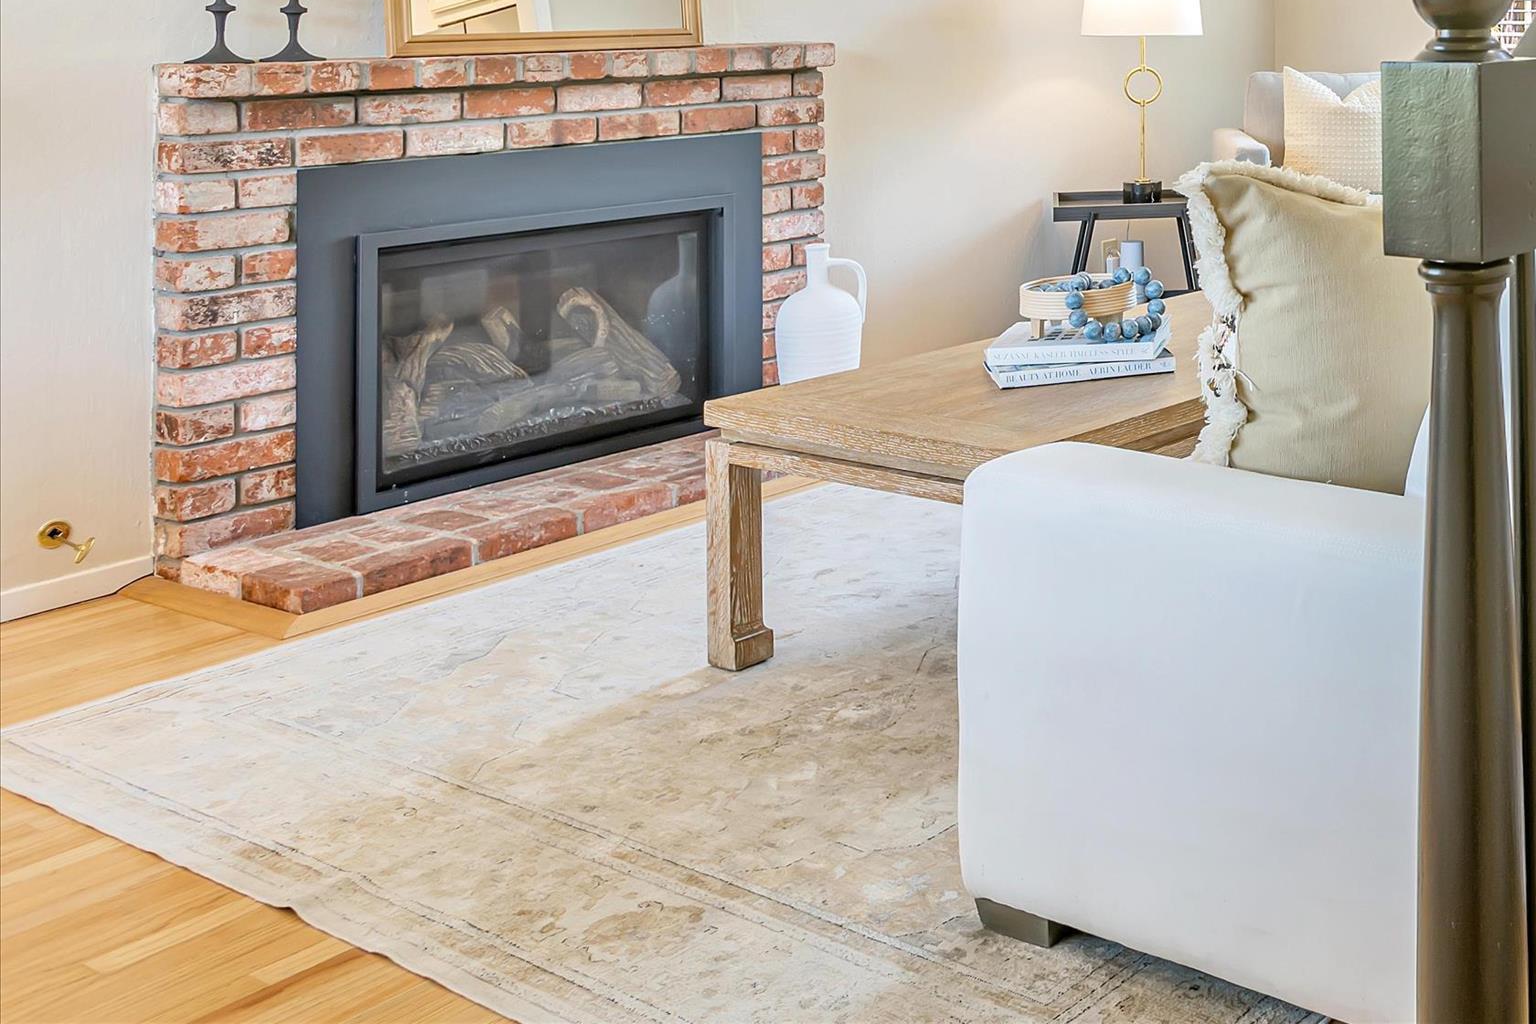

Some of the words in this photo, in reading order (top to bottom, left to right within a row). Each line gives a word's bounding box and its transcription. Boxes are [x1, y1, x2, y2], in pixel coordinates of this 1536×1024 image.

[1006, 372, 1040, 383] BEAUTY
[1055, 369, 1080, 378] HOME
[1088, 365, 1116, 375] AERIN
[1117, 362, 1152, 373] LAUDER
